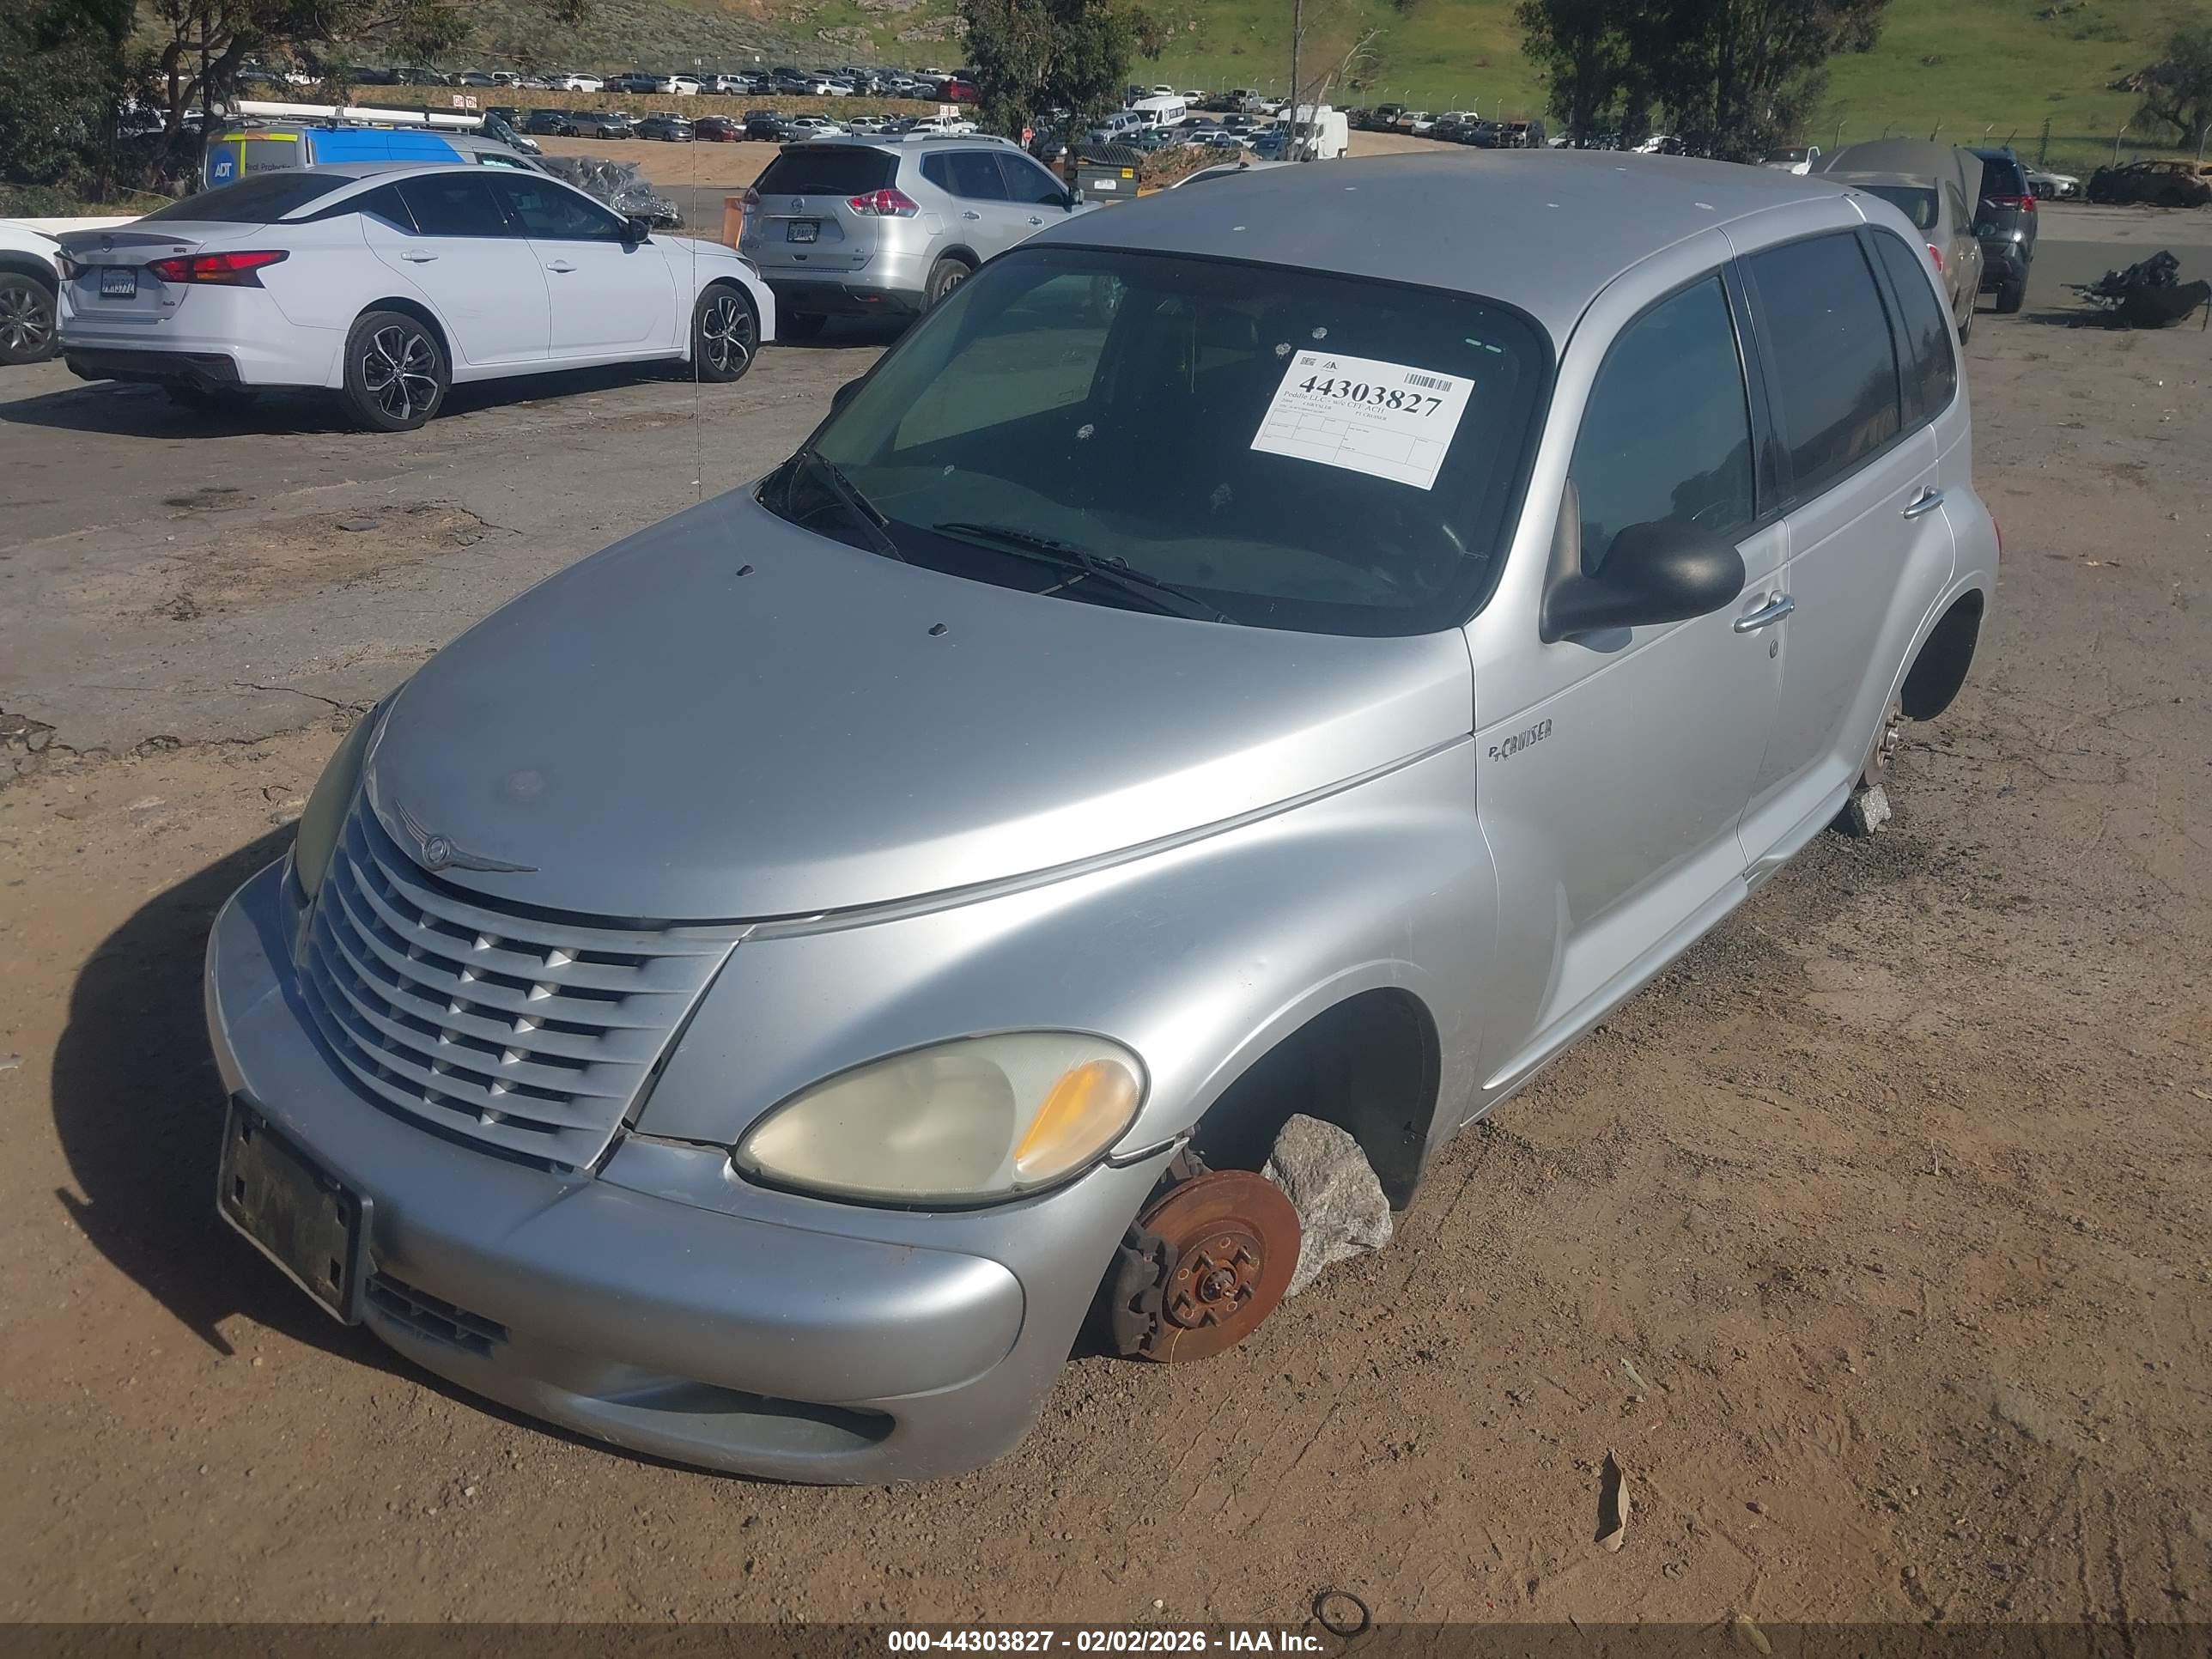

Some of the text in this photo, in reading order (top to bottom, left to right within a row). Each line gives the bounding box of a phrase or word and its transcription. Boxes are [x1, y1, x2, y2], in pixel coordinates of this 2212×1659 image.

[215, 162, 232, 177] ADT
[1284, 391, 1308, 400] Peddle
[1309, 394, 1327, 403] LLC
[1299, 375, 1443, 416] 44303827
[1501, 719, 1552, 758] CRUISER
